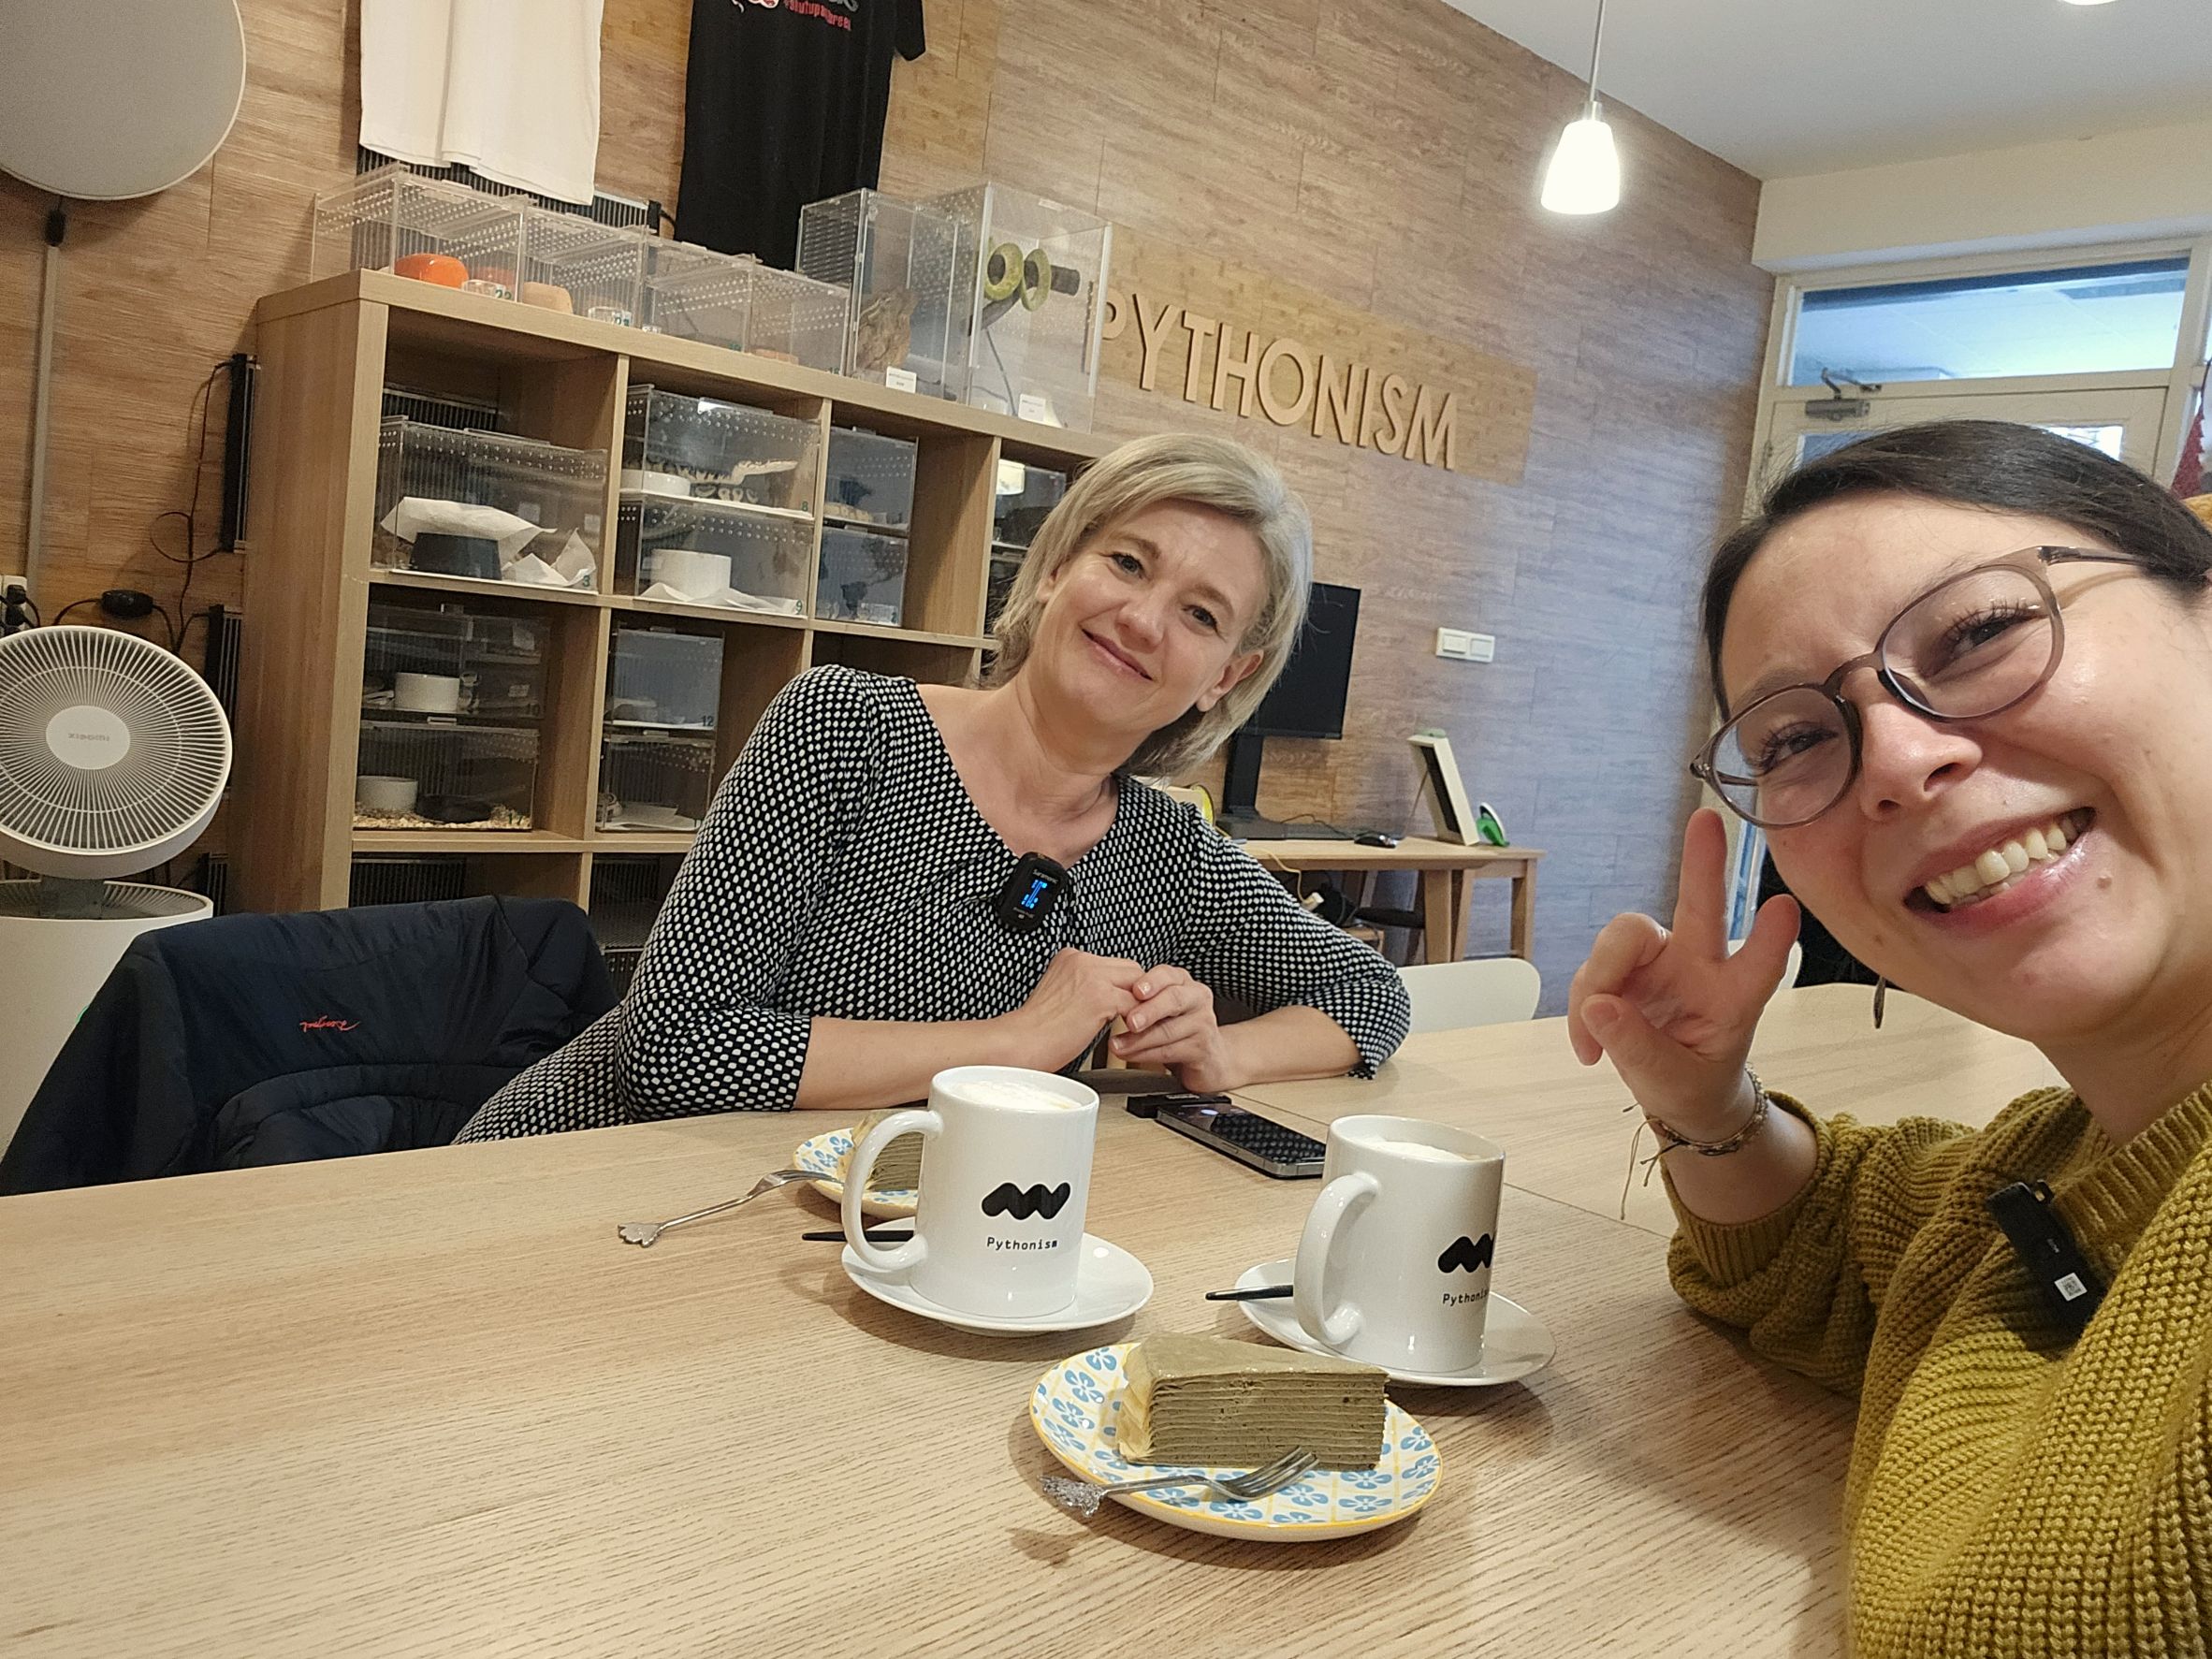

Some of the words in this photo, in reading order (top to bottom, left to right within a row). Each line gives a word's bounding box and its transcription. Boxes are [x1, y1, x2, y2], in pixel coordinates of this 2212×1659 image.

[1101, 287, 1457, 470] PYTHONISM
[801, 501, 808, 512] 8
[582, 575, 591, 588] 3
[795, 600, 803, 615] 9
[702, 715, 714, 727] 12
[986, 1236, 1058, 1251] Pythonism
